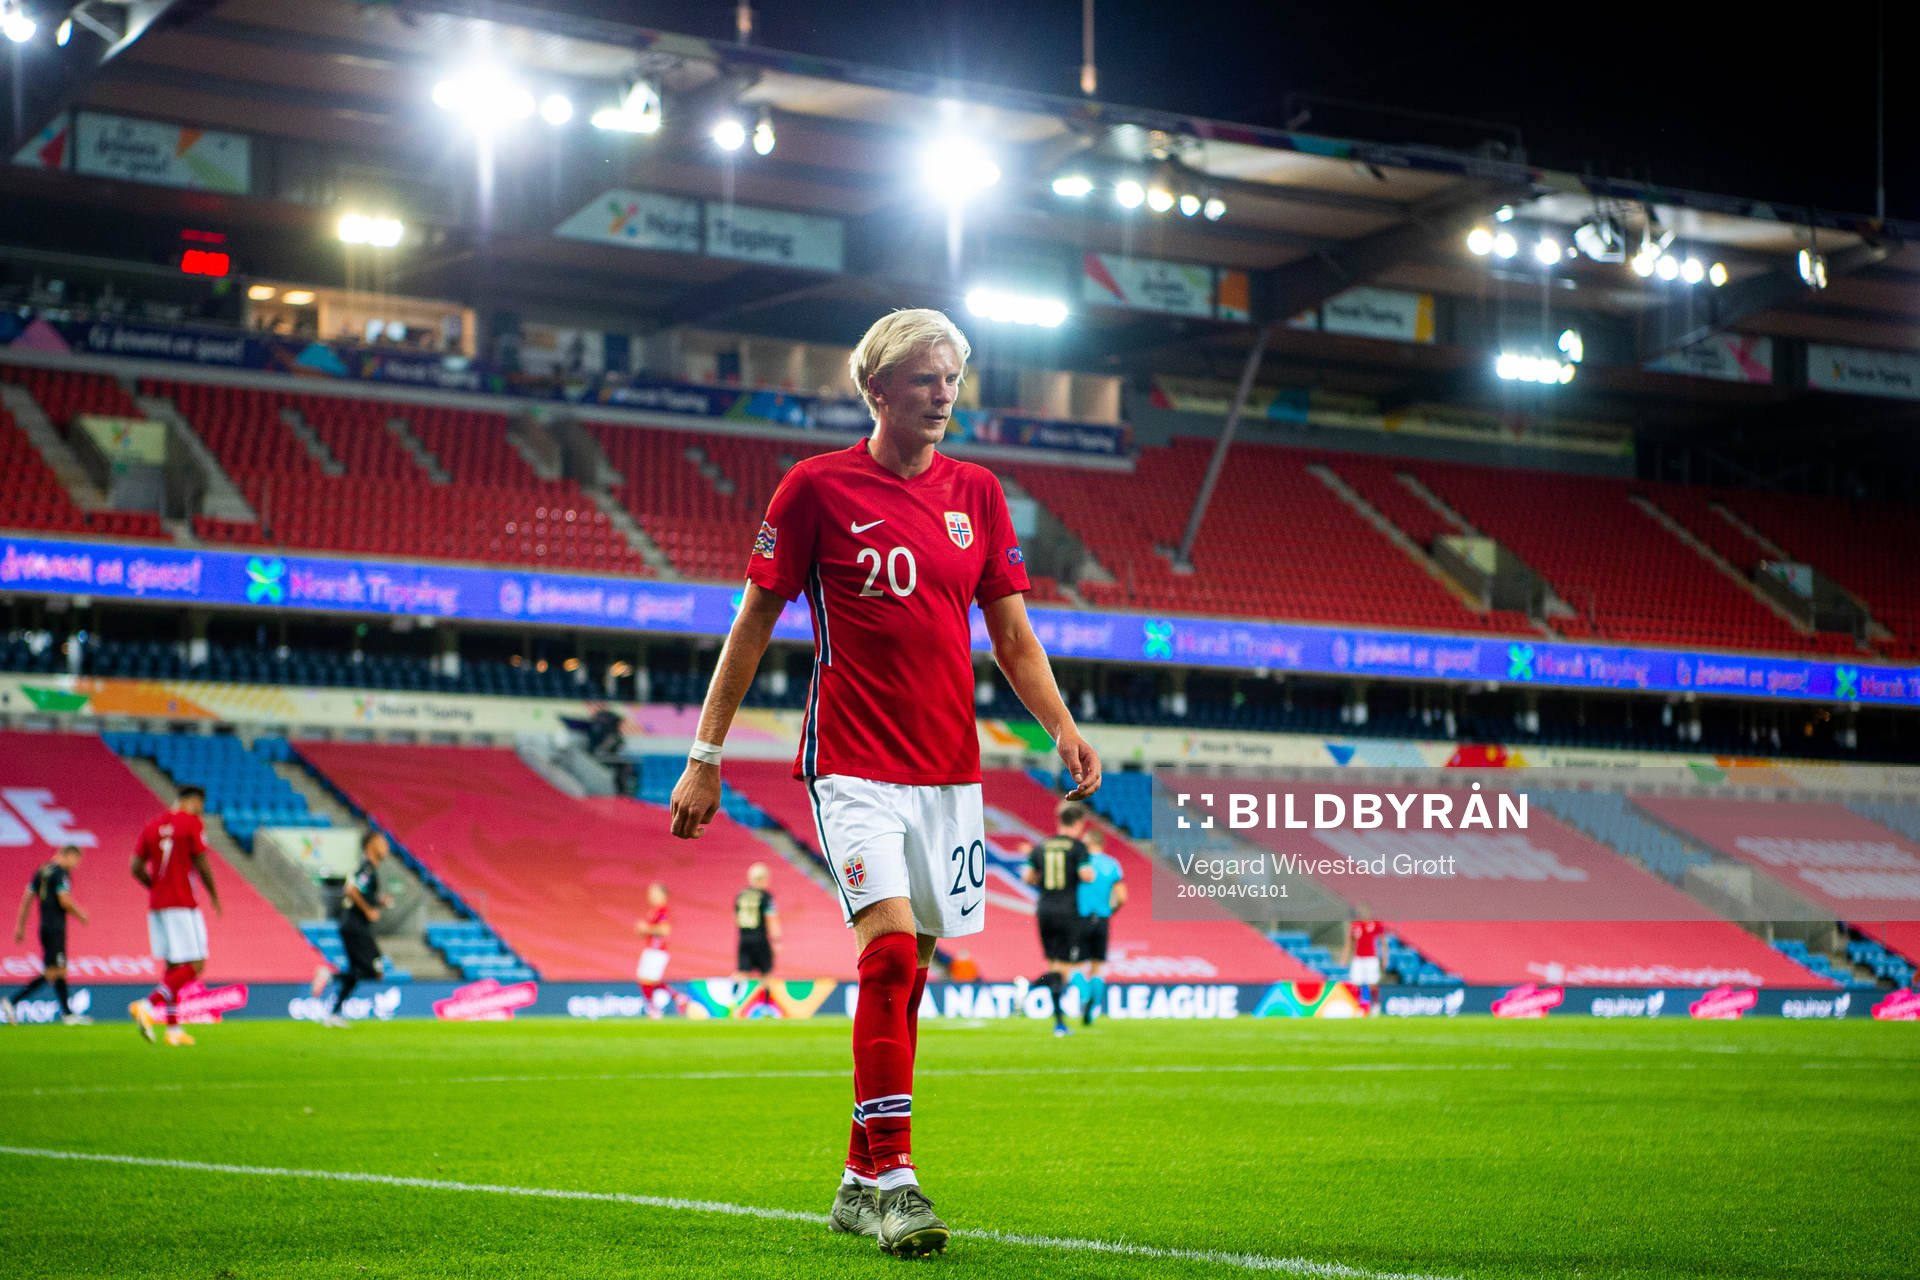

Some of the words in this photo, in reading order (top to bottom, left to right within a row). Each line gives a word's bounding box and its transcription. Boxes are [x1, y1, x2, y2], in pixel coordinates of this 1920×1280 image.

[856, 546, 917, 597] 20
[159, 837, 174, 878] 7
[950, 839, 985, 896] 20
[1044, 850, 1066, 890] 11
[1107, 984, 1239, 1019] LEAGUE
[1385, 993, 1446, 1018] equinor
[1590, 995, 1646, 1018] equinor
[1781, 997, 1833, 1020] equinor
